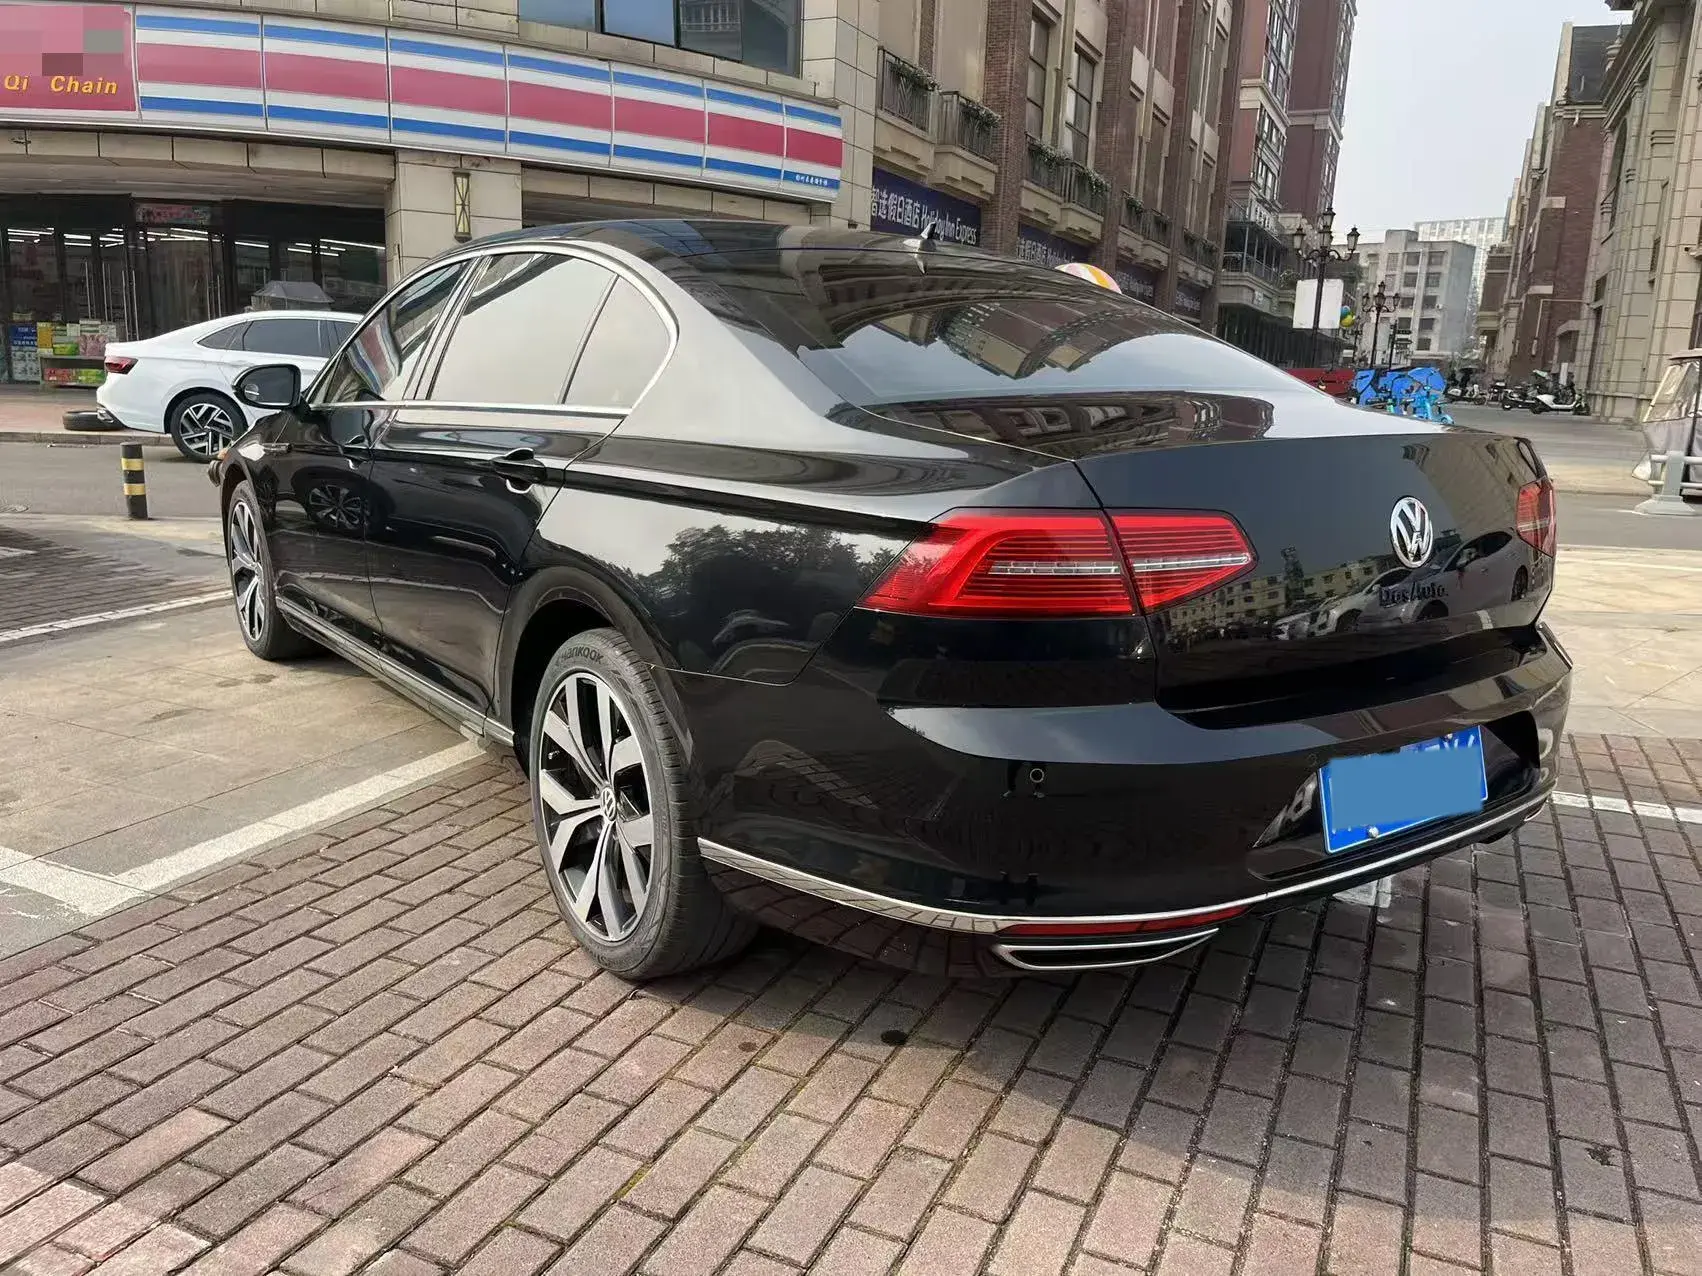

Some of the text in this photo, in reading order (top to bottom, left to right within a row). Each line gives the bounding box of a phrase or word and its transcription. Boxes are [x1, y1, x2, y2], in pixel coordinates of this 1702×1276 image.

[4, 75, 119, 95] Qi Chain
[955, 217, 977, 246] Express
